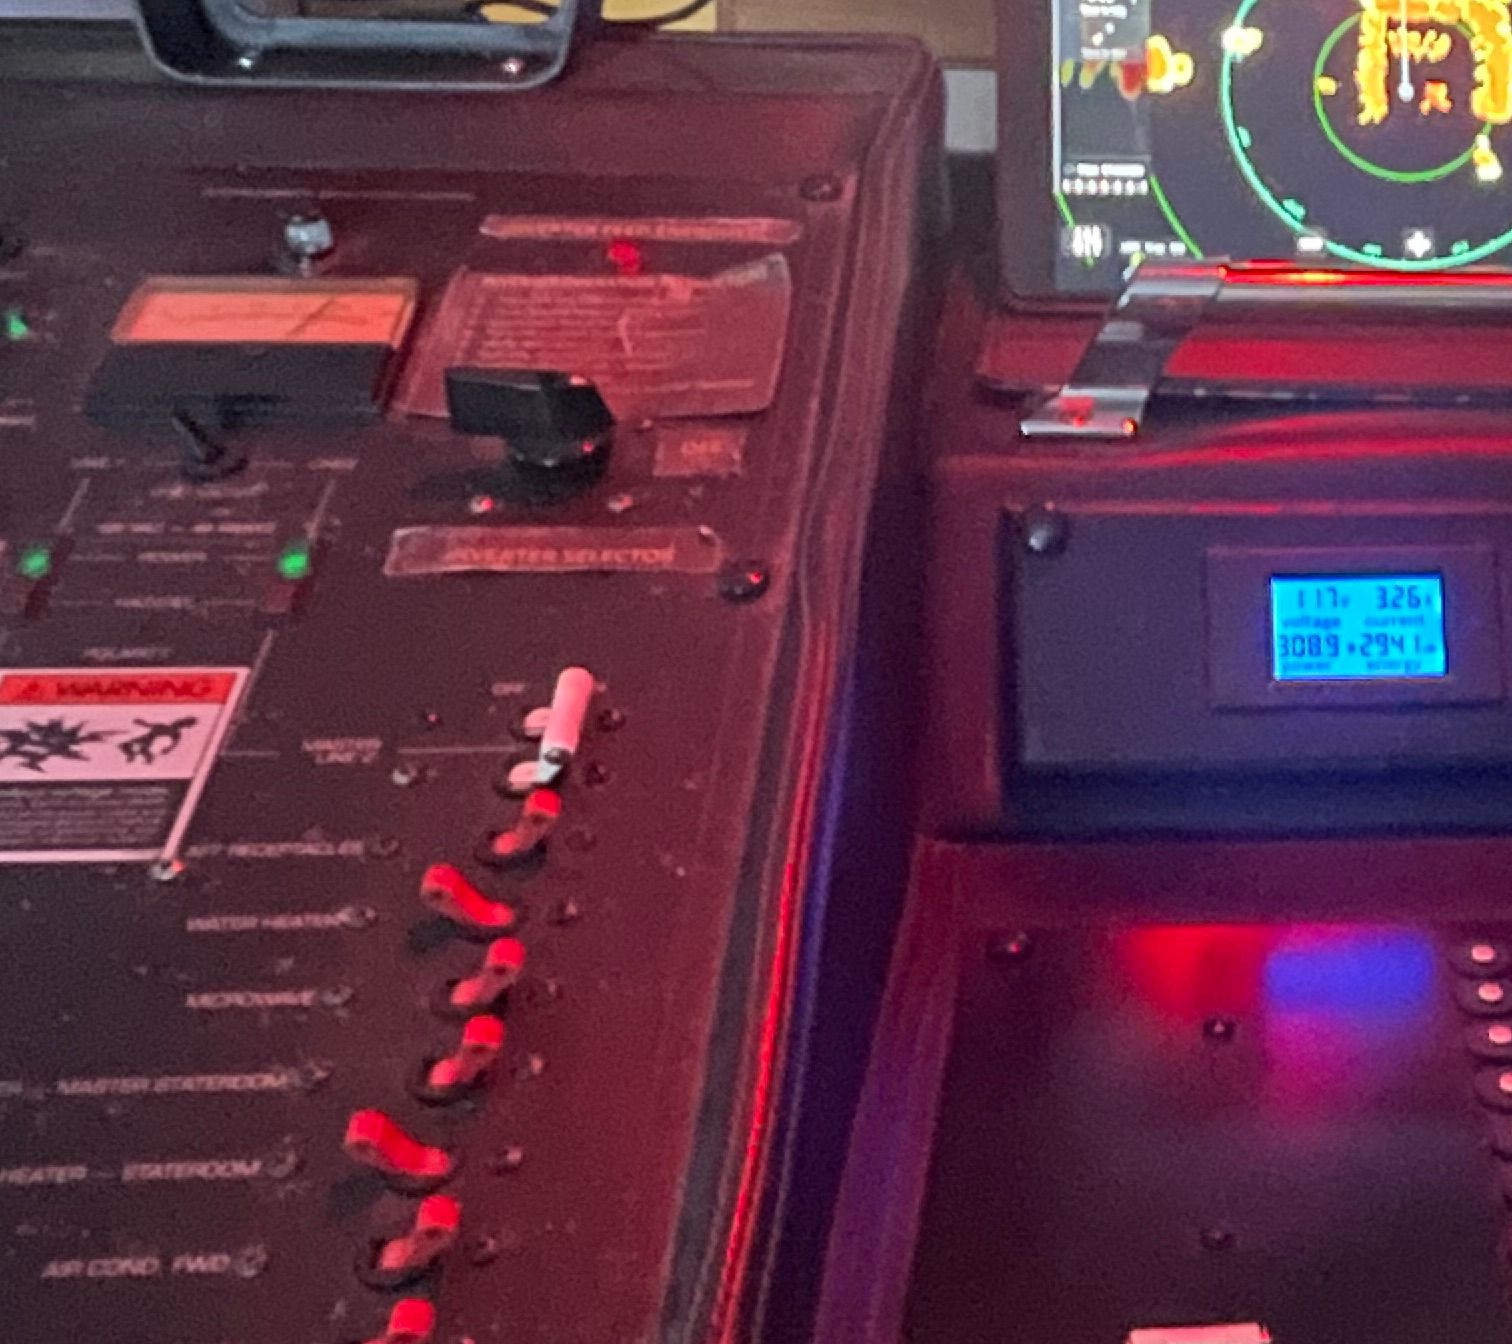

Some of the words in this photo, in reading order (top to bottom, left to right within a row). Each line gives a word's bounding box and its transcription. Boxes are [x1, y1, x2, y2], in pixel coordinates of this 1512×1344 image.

[56, 670, 213, 697] WARNING
[184, 990, 316, 1007] MICROWAVE
[57, 1078, 149, 1095] MASTER
[121, 1159, 261, 1180] STATEROOM
